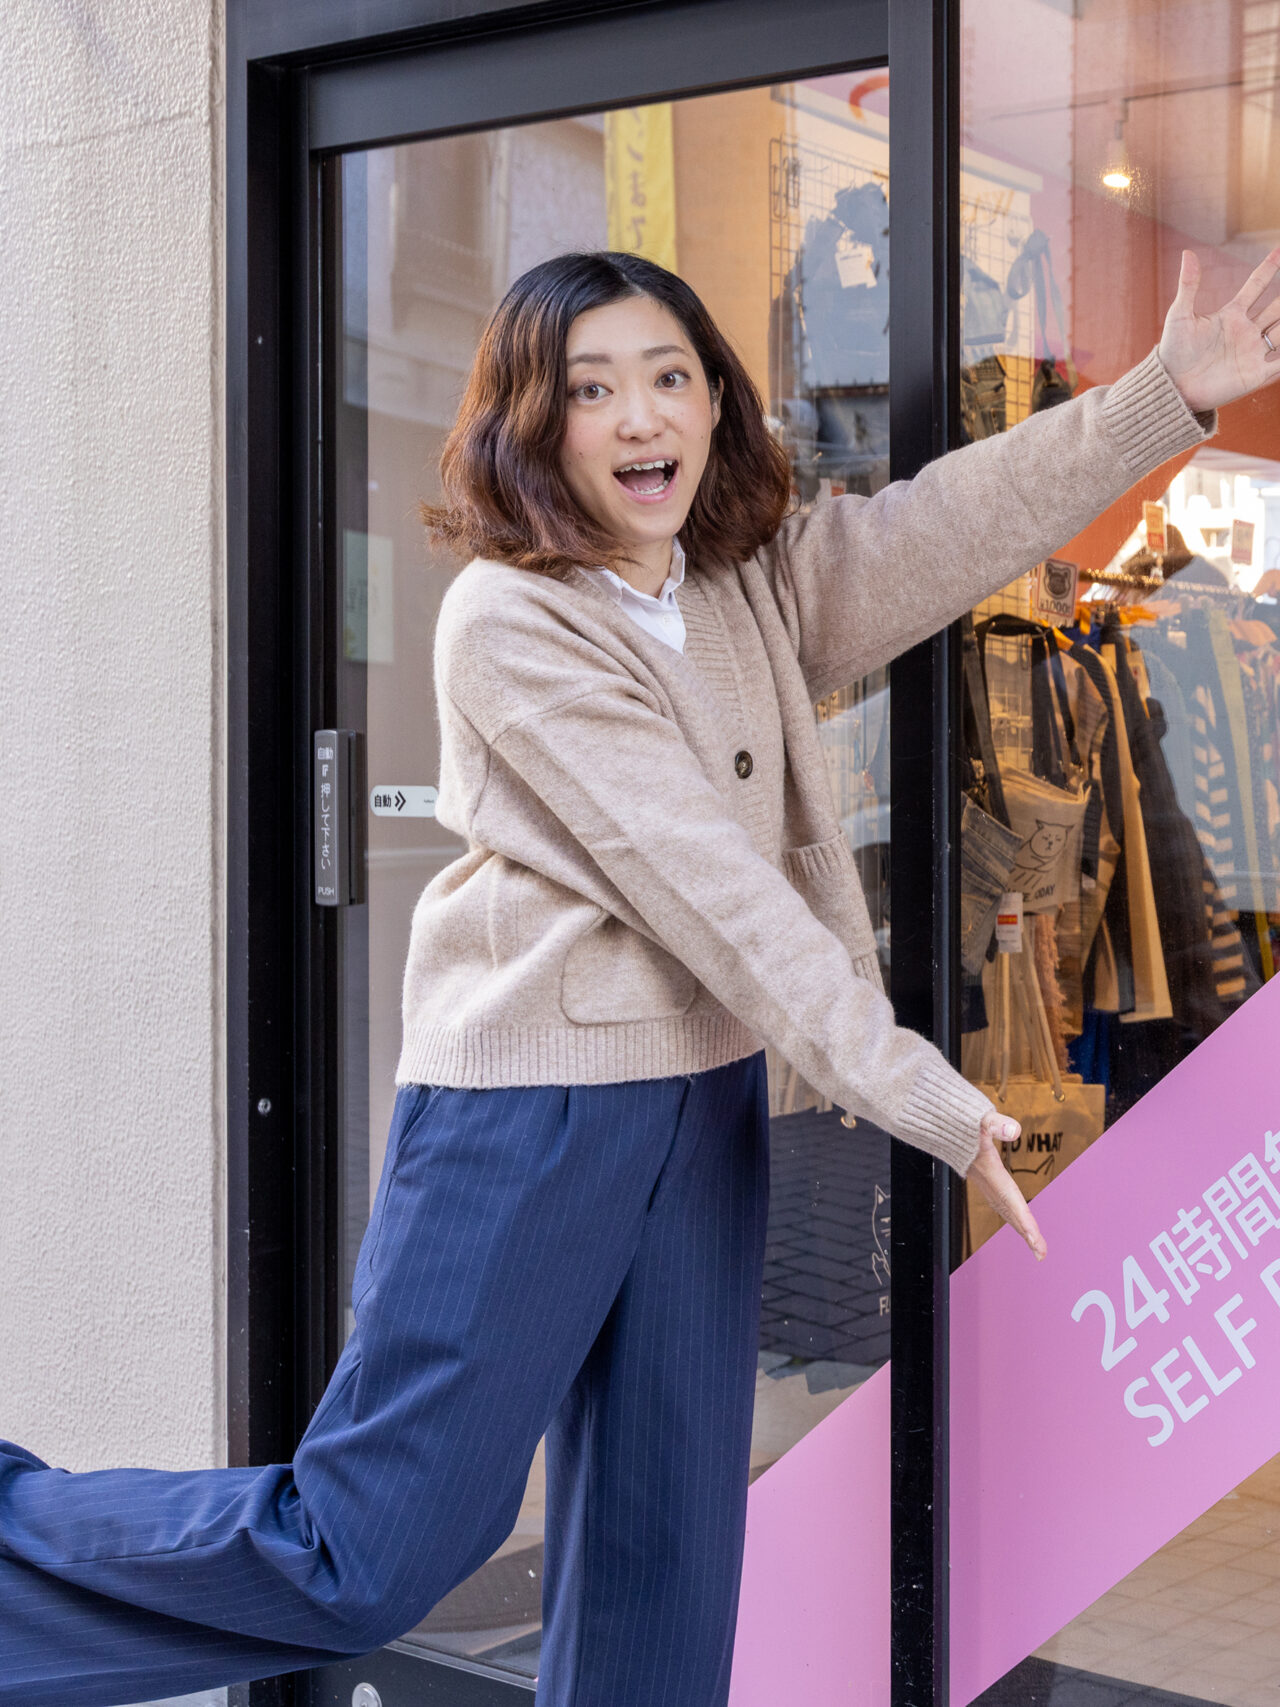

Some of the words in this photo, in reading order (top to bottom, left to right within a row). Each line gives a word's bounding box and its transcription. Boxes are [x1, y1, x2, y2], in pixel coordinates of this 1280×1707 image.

[317, 746, 334, 760] 自動
[374, 794, 392, 808] 自動
[320, 782, 331, 870] 押して下さい
[317, 886, 335, 896] PUSH
[1122, 1292, 1258, 1448] SELF
